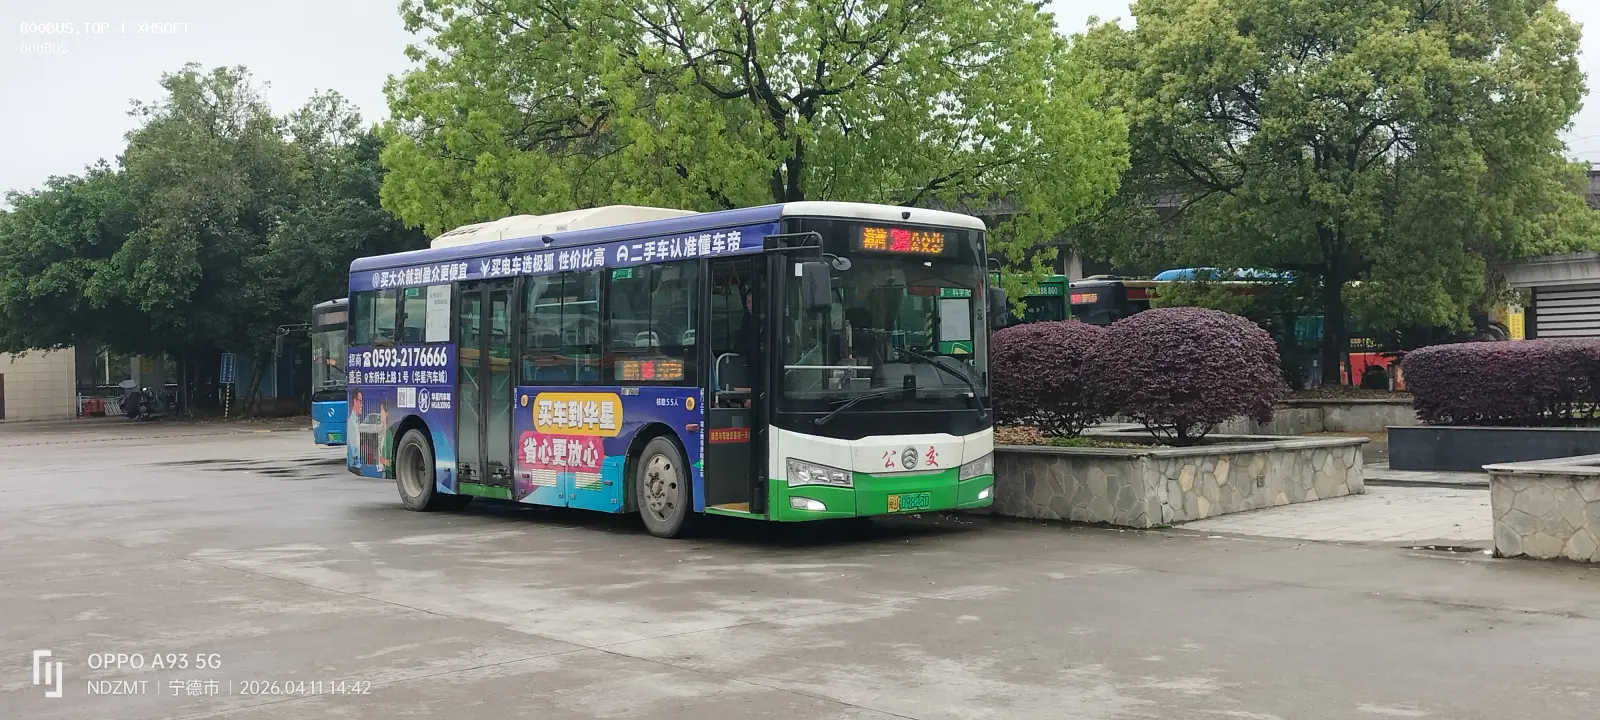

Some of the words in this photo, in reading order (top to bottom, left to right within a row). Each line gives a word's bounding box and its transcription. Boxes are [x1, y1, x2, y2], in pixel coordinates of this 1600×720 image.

[630, 230, 741, 262] 二手车认准懂车帝
[380, 262, 468, 288] 买大众就到盈众更便宜
[490, 252, 555, 276] 买电车选极狐
[558, 247, 606, 271] 性价比高
[348, 353, 362, 367] 招商
[372, 346, 447, 368] 0593-2176666
[348, 370, 362, 384] 盛启
[538, 400, 615, 430] 买车到华星
[523, 437, 599, 467] 省心更放心
[882, 451, 897, 469] 公
[925, 446, 939, 467] 交
